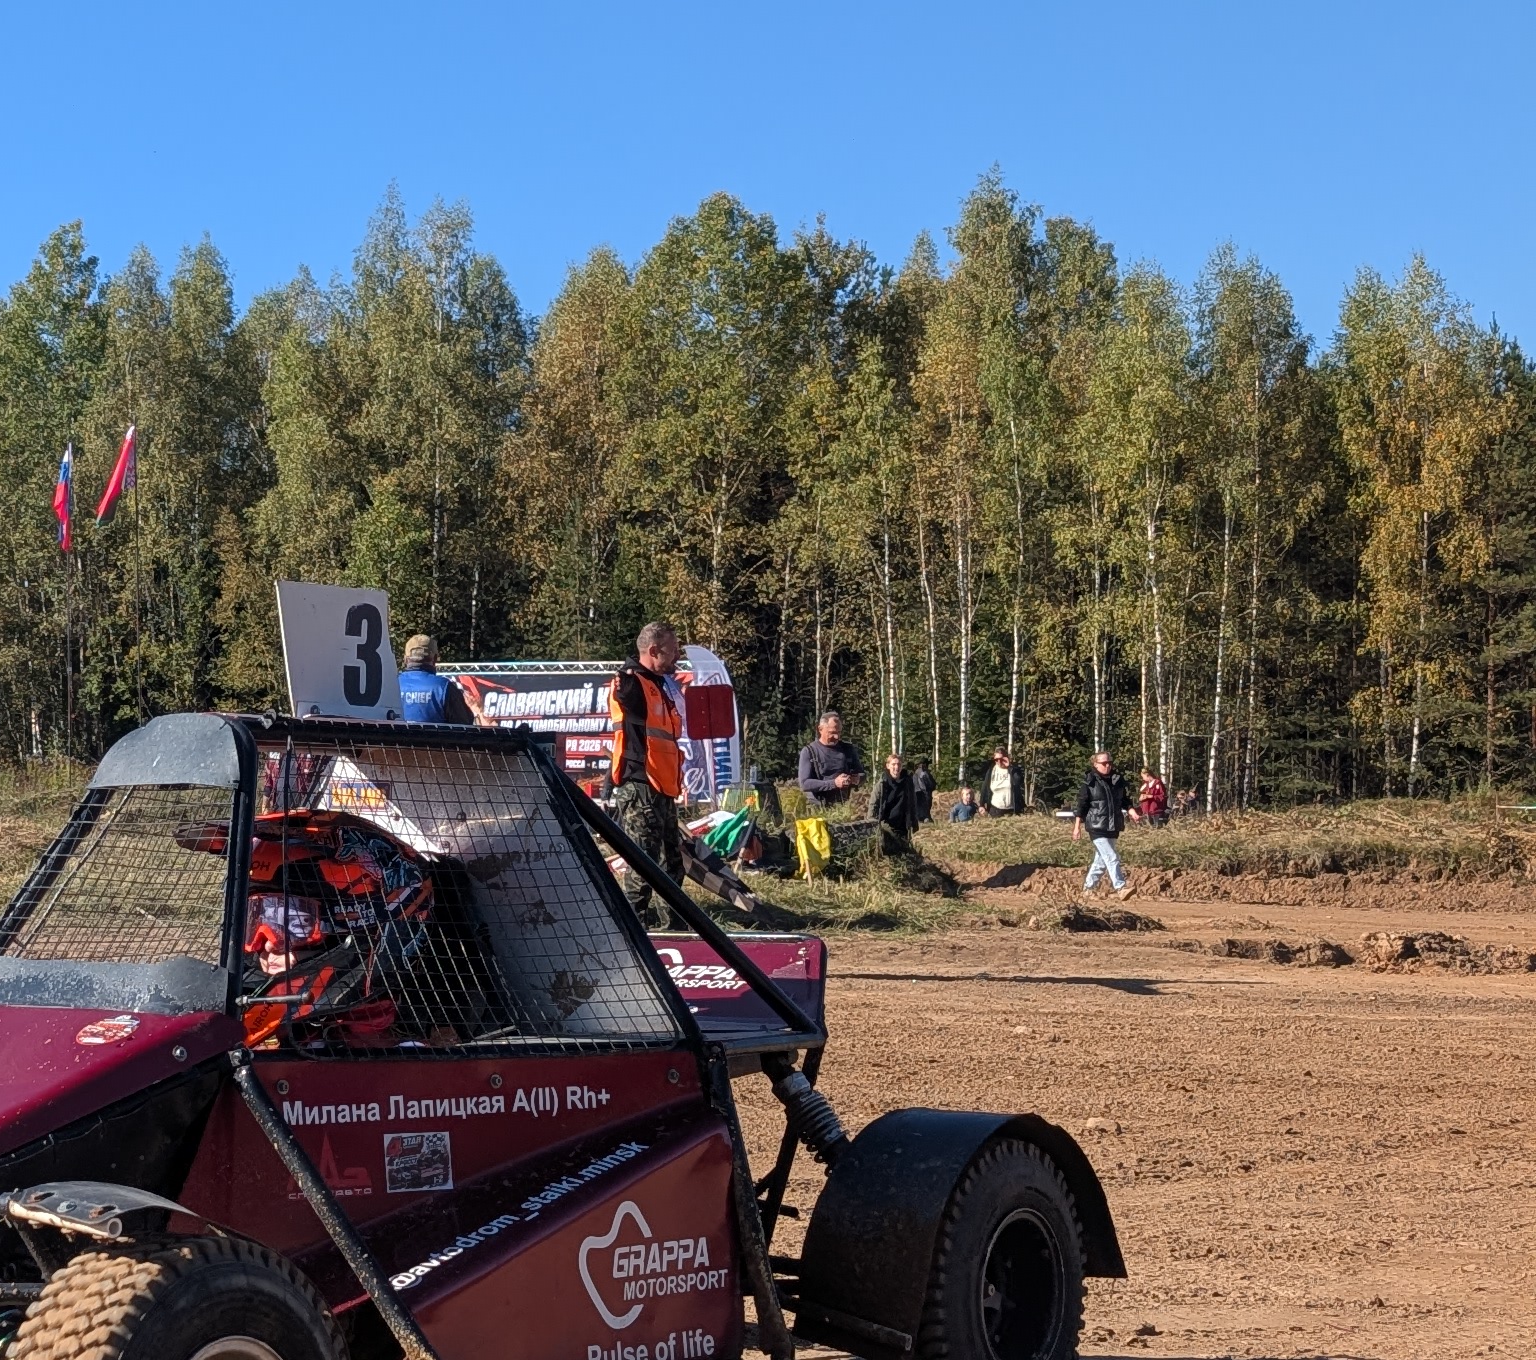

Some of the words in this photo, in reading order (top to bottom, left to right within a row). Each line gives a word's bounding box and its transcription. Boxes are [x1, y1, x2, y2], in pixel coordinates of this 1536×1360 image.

[343, 602, 383, 707] 3
[484, 683, 593, 717] СЛАВЯНСКИЙ
[578, 739, 601, 752] 2026
[334, 903, 366, 913] READY
[664, 965, 738, 980] APPA
[672, 979, 748, 990] RSPORT
[283, 1101, 380, 1126] Милана
[388, 1092, 505, 1120] Лапицкая
[566, 1086, 611, 1109] Rh+
[288, 1187, 372, 1200] СПАВТО
[612, 1237, 710, 1279] GRAPPA
[623, 1269, 728, 1301] MOTORSPORT
[681, 1328, 715, 1359] life
